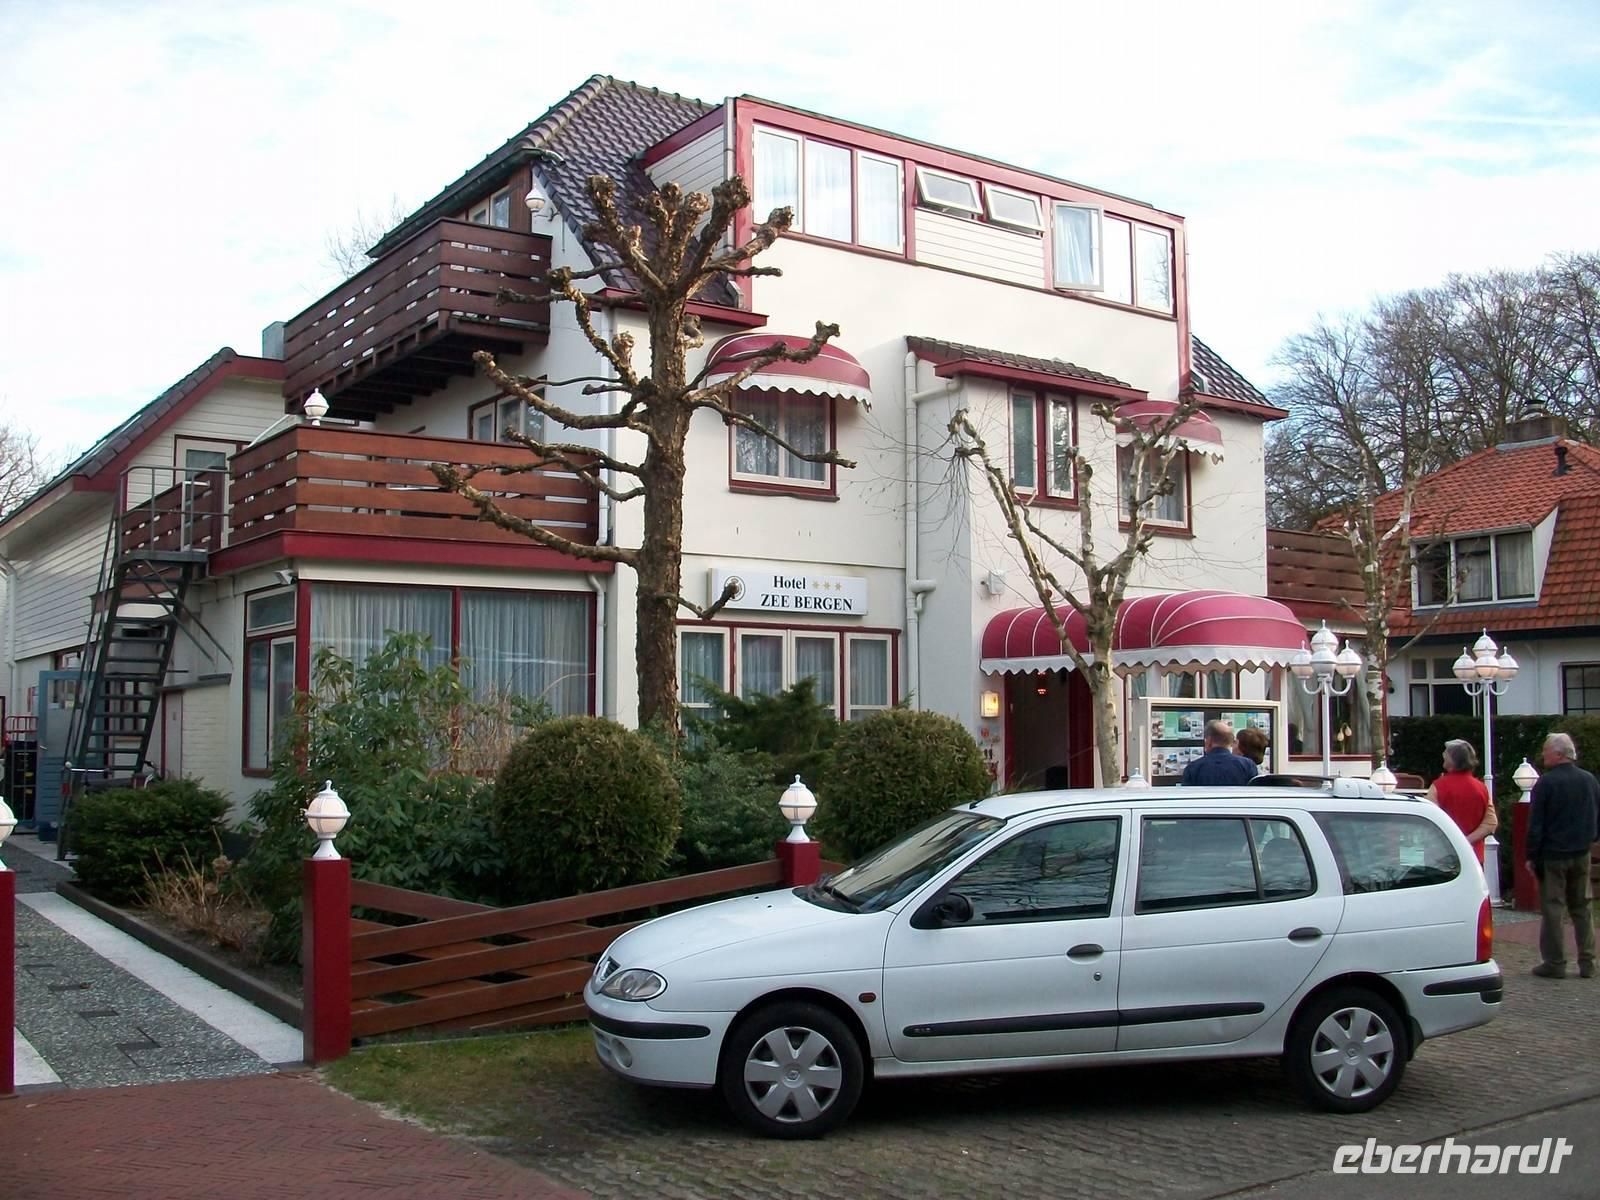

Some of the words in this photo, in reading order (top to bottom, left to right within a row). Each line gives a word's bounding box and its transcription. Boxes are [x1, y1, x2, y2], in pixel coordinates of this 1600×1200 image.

[774, 576, 806, 589] Hotel
[761, 593, 789, 608] ZEE
[794, 595, 853, 611] BERGEN
